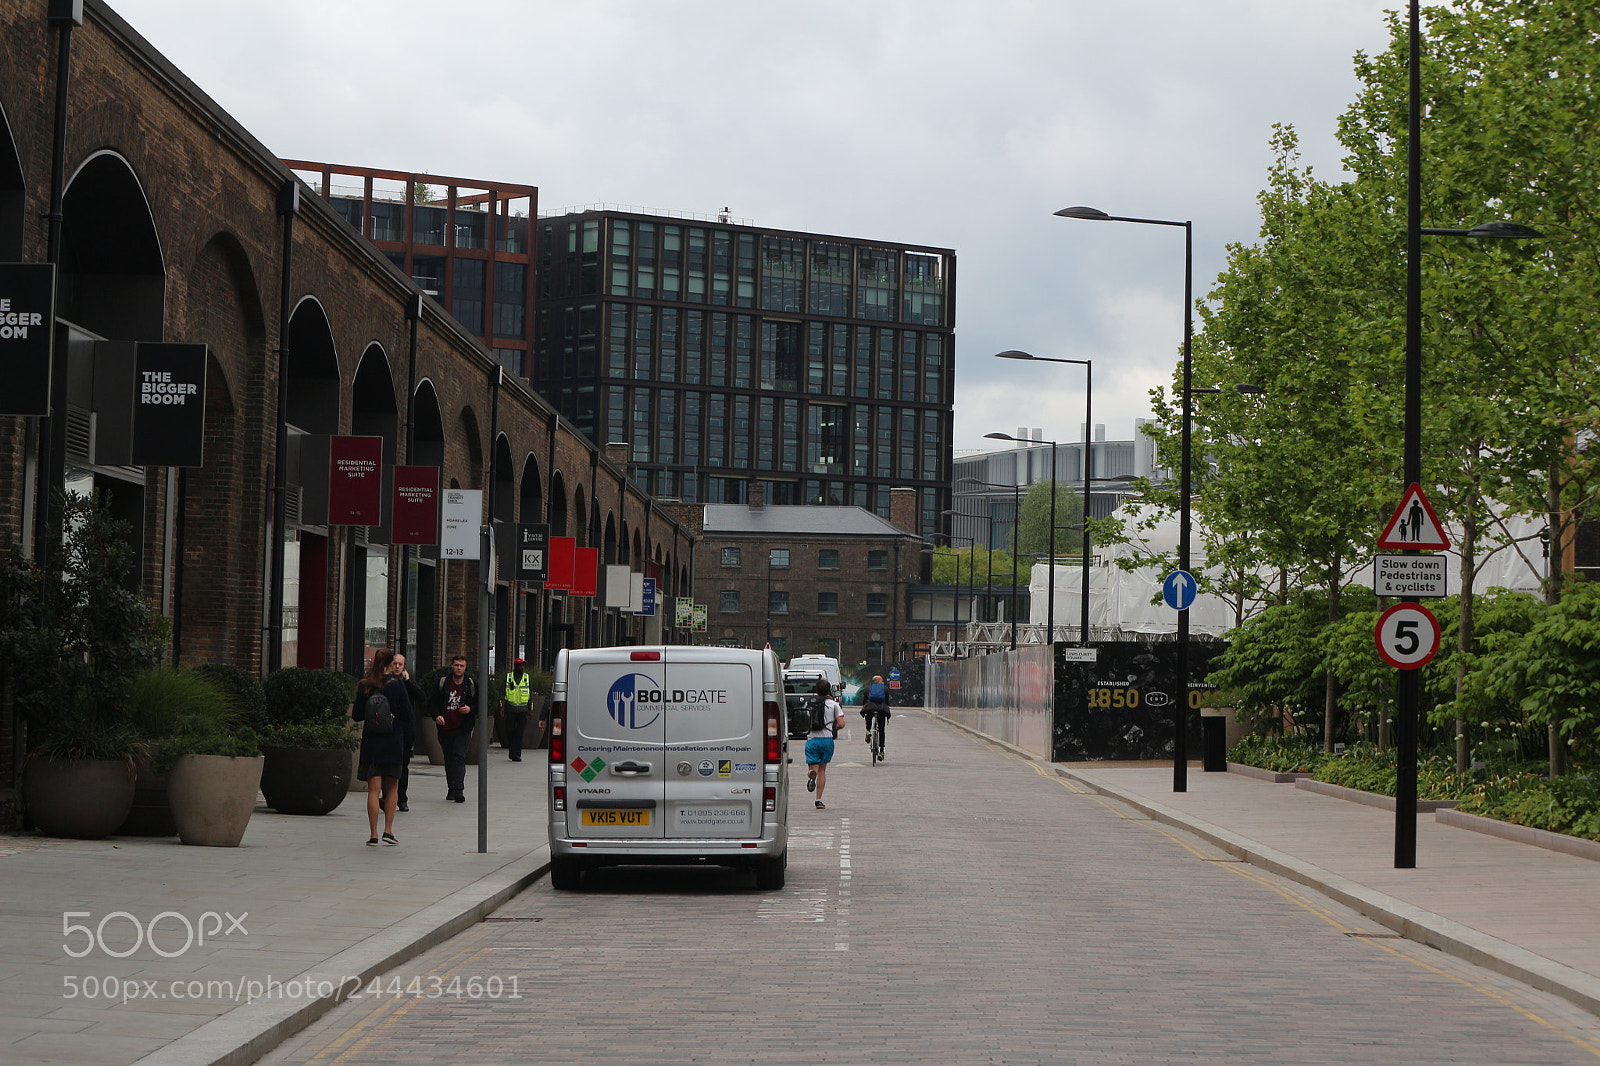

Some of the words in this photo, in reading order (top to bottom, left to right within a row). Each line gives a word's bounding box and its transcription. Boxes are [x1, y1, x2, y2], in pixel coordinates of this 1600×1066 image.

[142, 372, 172, 383] THE
[141, 383, 197, 395] BIGGER
[141, 394, 186, 405] ROOM
[445, 548, 464, 556] 12-13
[524, 554, 540, 563] KX
[1381, 559, 1408, 569] Slow
[1411, 560, 1440, 570] down
[1380, 570, 1442, 581] Pedestrians
[1385, 582, 1393, 591] &
[1395, 582, 1436, 592] cyclists
[1394, 620, 1420, 655] 5
[637, 689, 727, 704] BOLDGATE
[1087, 688, 1139, 708] 1850
[636, 704, 679, 712] COMMERCIAL
[680, 704, 711, 712] SERVICES
[577, 745, 612, 753] Catering
[725, 745, 752, 753] Repair
[590, 811, 617, 823] VK15
[621, 811, 643, 823] VUT
[680, 818, 745, 826] www.boldgate.co.uk
